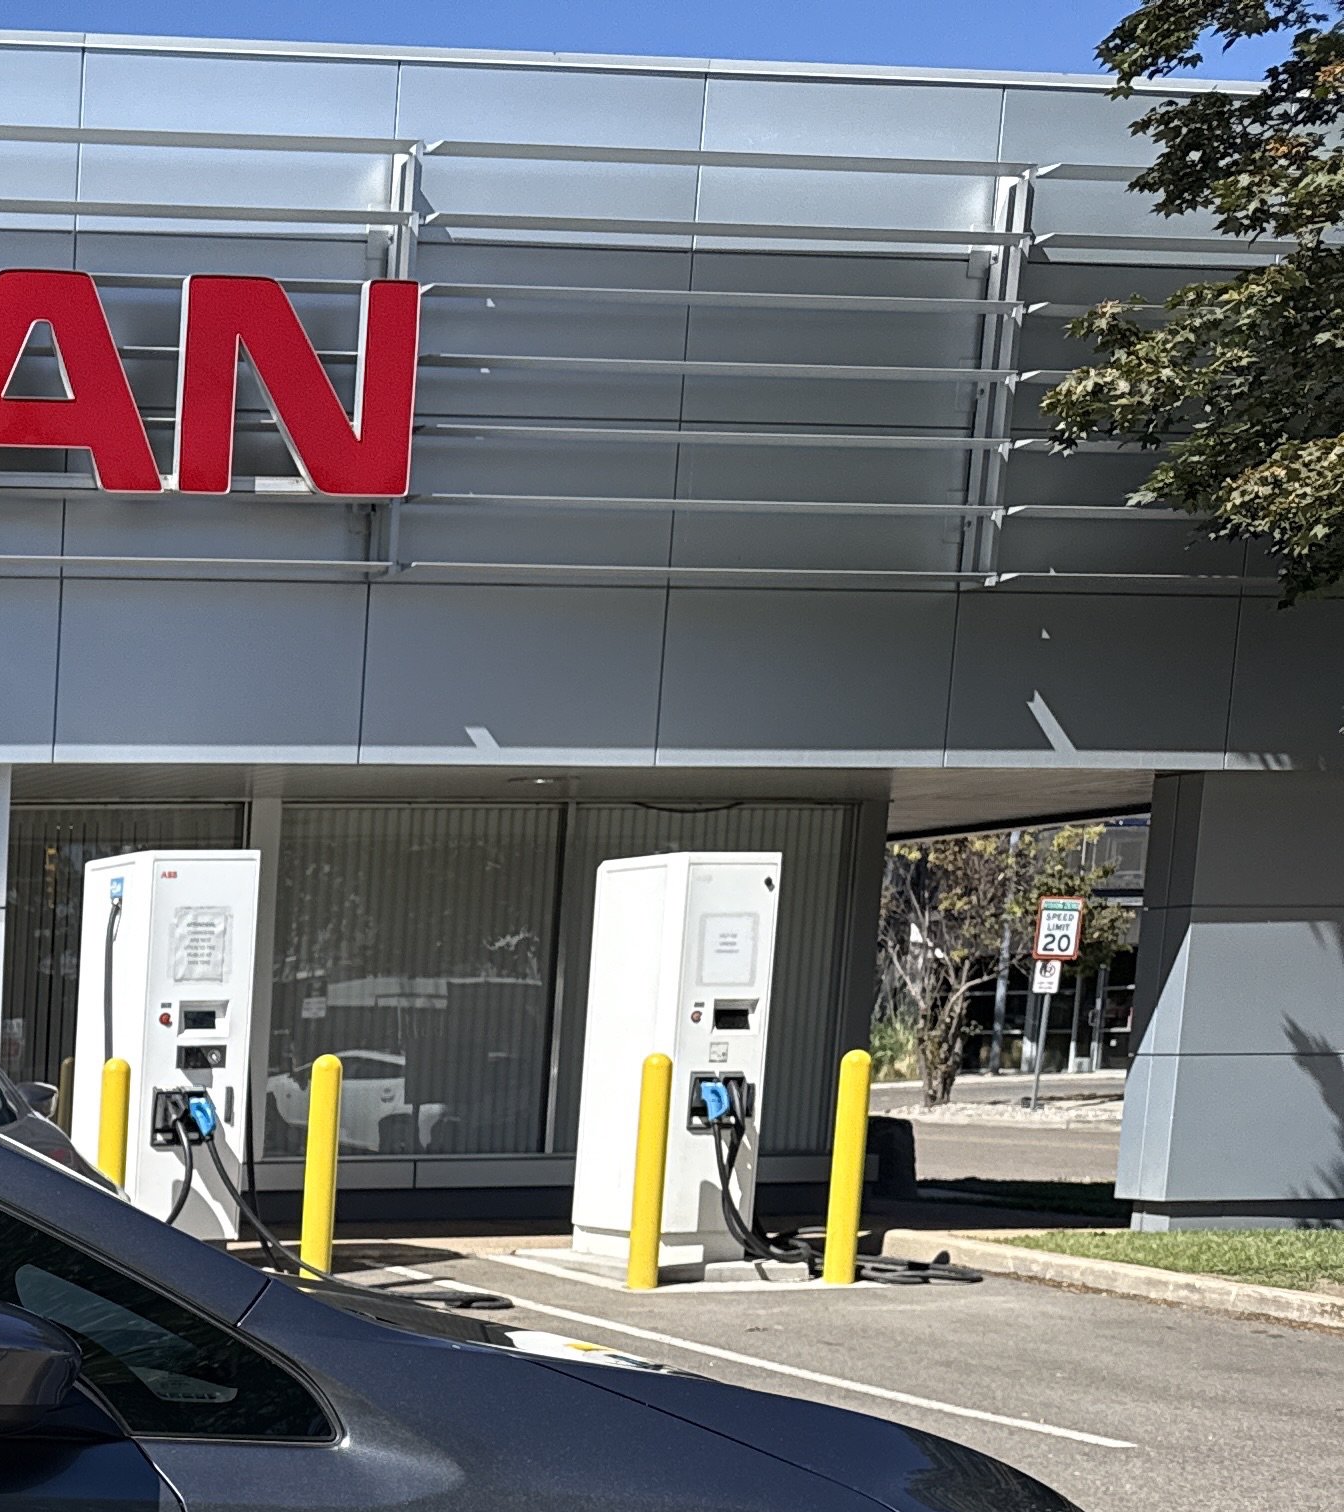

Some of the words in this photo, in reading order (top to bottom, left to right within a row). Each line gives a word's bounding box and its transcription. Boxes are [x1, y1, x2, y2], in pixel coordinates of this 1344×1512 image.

[160, 871, 178, 879] ABB
[1045, 912, 1075, 922] SPEED
[1046, 923, 1071, 932] LIMIT
[1042, 933, 1071, 953] 20
